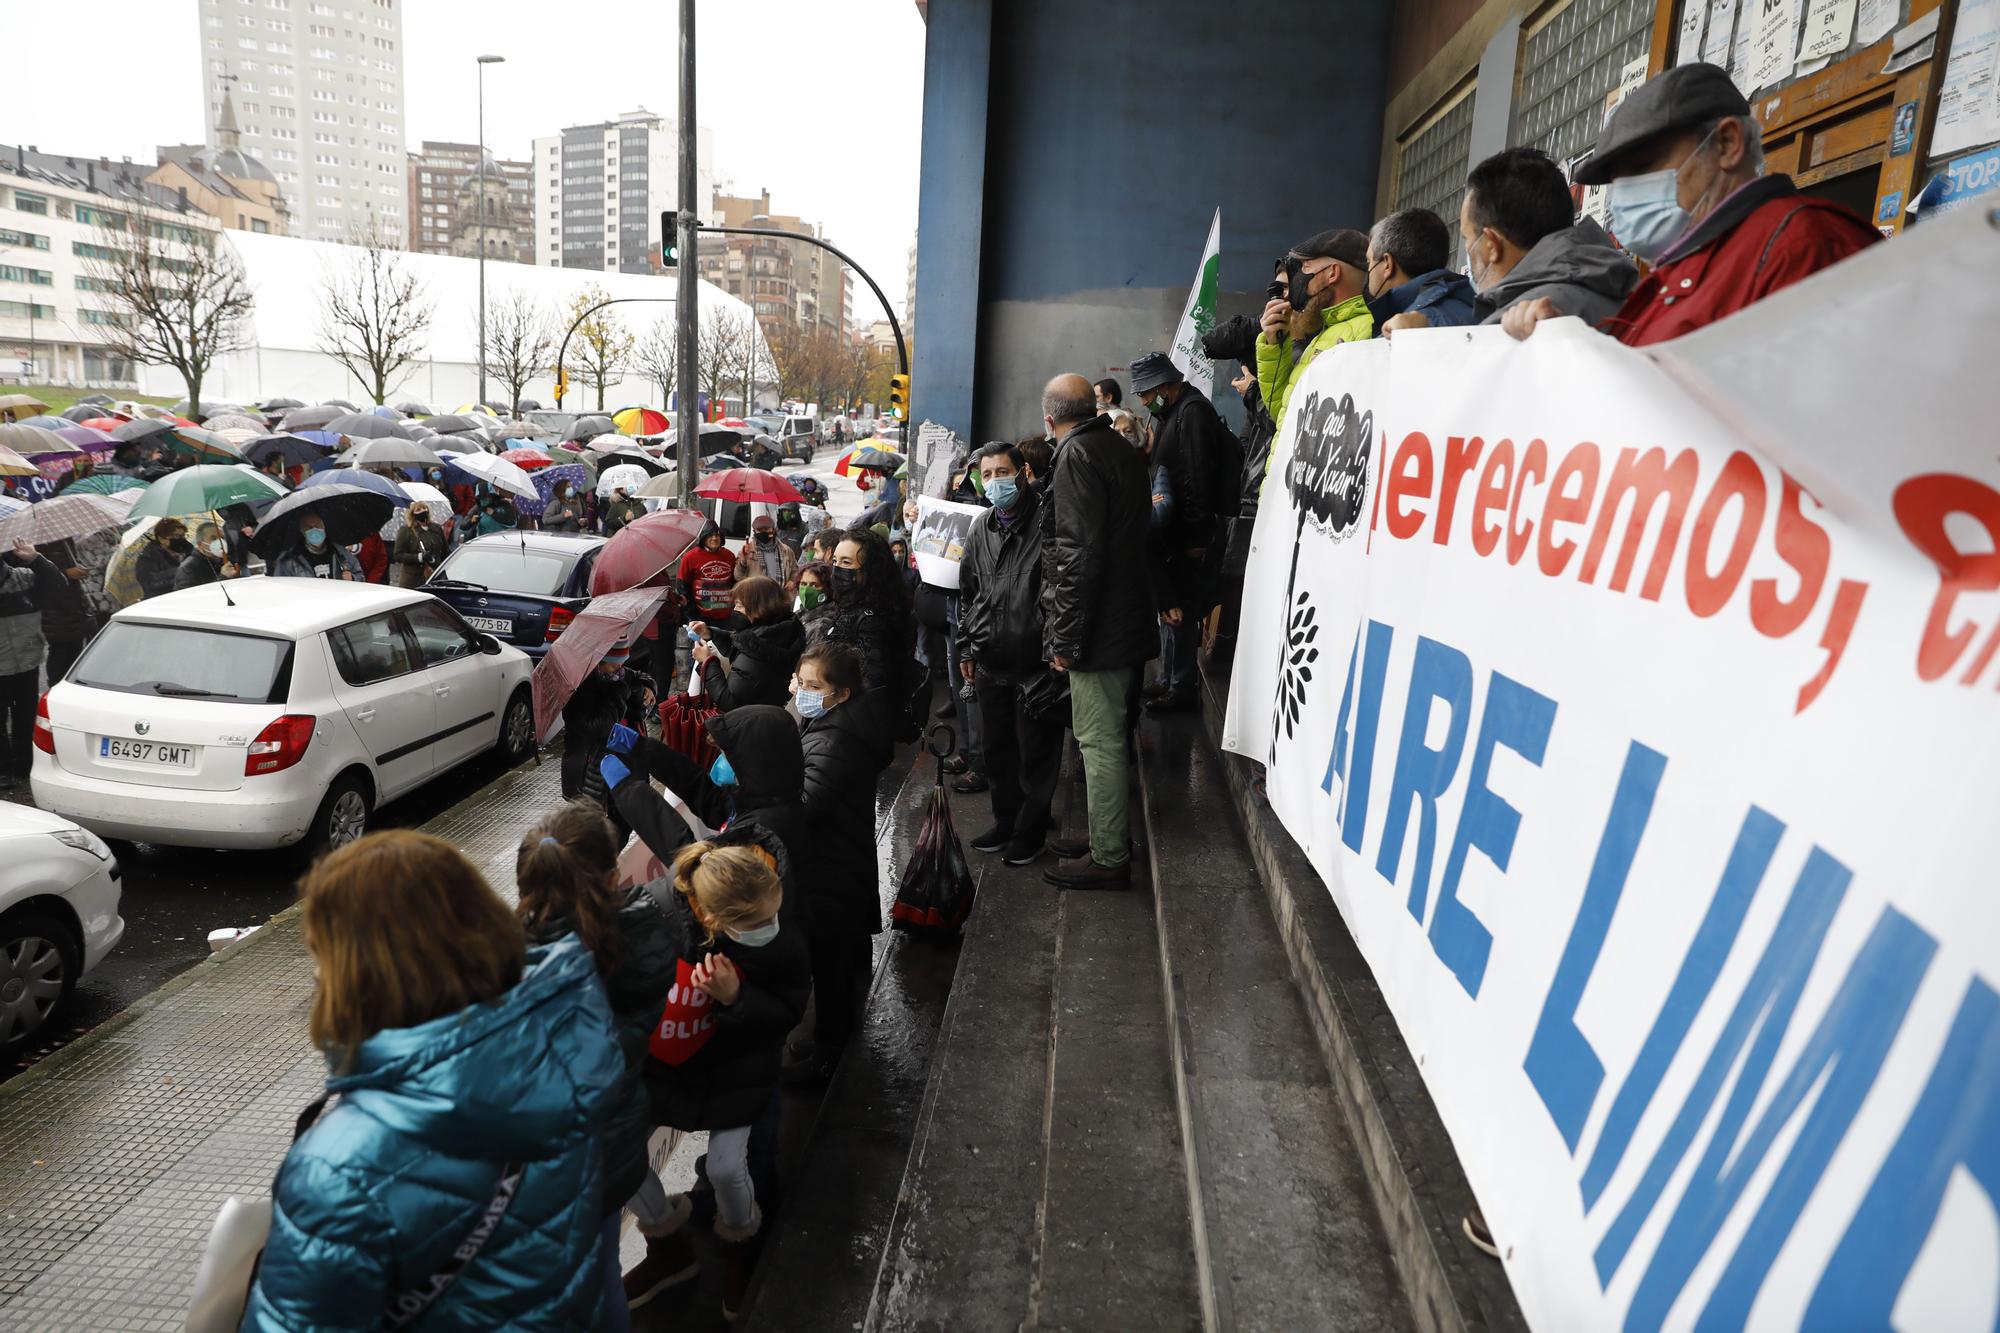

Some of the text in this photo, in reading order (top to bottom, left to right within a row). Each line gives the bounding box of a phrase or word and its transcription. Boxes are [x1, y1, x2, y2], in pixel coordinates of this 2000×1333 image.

[1764, 39, 1775, 54] EN
[1823, 10, 1836, 25] EN
[1366, 430, 1869, 717] erecemos,
[111, 740, 191, 765] 6497 GMT
[1320, 615, 1559, 1002] AIRE
[384, 1173, 521, 1326] LOLA BIMBA
